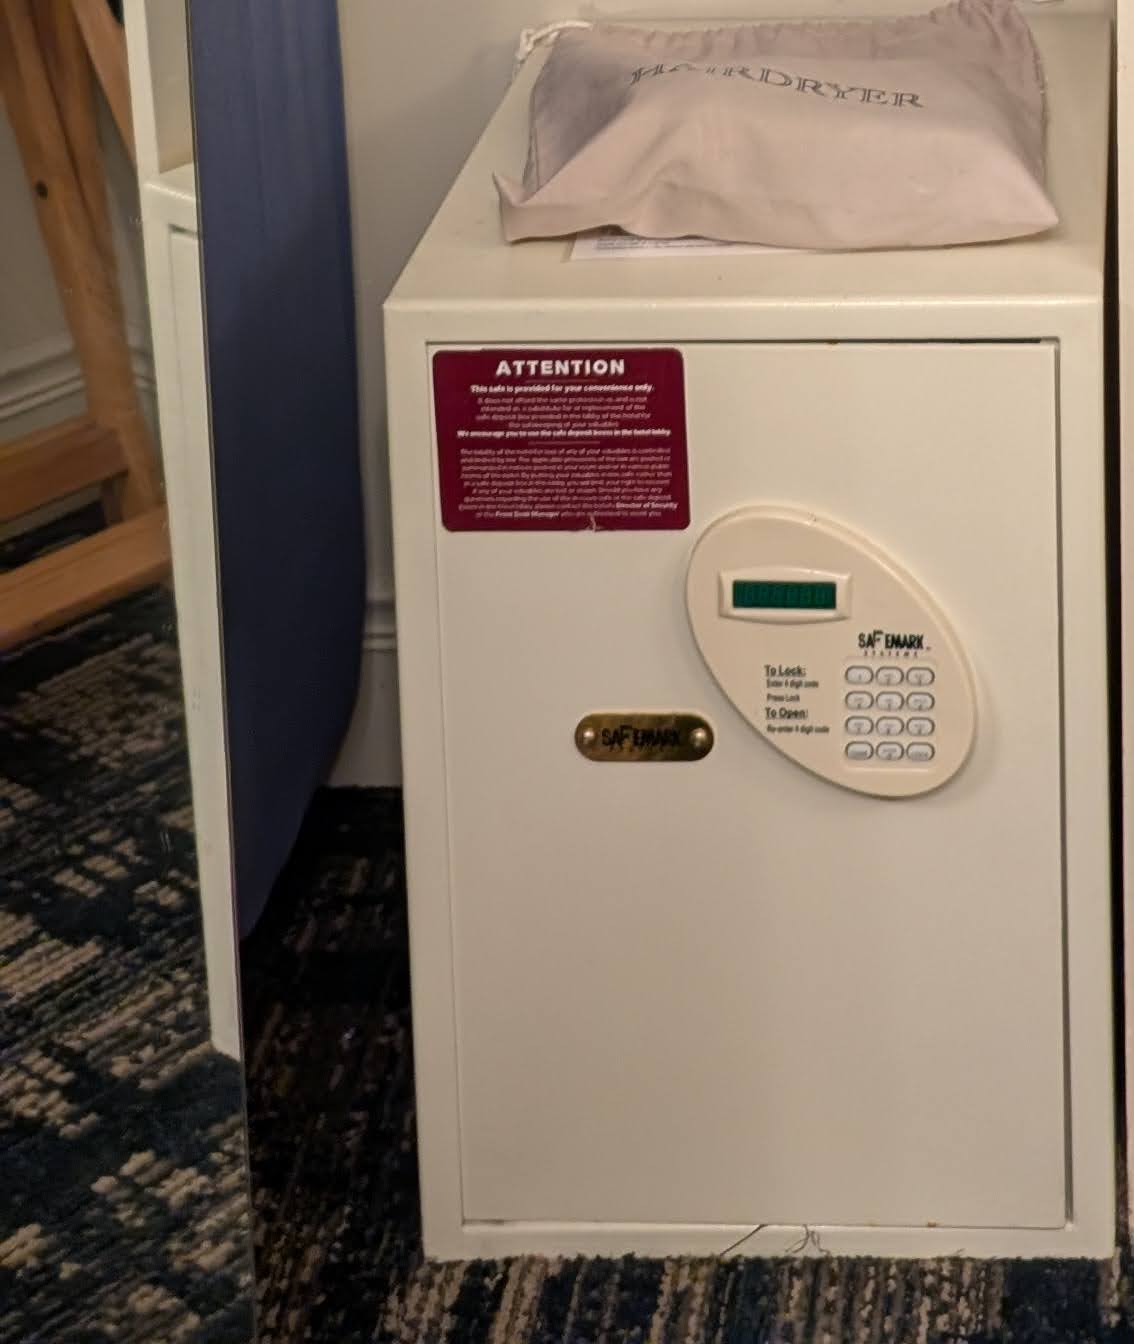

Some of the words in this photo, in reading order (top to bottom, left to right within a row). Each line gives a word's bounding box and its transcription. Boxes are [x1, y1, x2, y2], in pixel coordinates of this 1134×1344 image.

[495, 359, 625, 377] ATTENTION
[470, 384, 488, 393] This
[489, 384, 506, 393] safe
[507, 385, 514, 393] is
[514, 384, 551, 394] provided
[551, 383, 563, 393] for
[564, 384, 583, 394] your
[583, 384, 634, 393] convenience
[857, 629, 925, 651] SAFEMARK
[764, 665, 776, 676] To
[779, 665, 806, 677] Lock:
[765, 707, 777, 719] To
[779, 707, 808, 720] Open:
[601, 724, 680, 747] SAFEMARK
